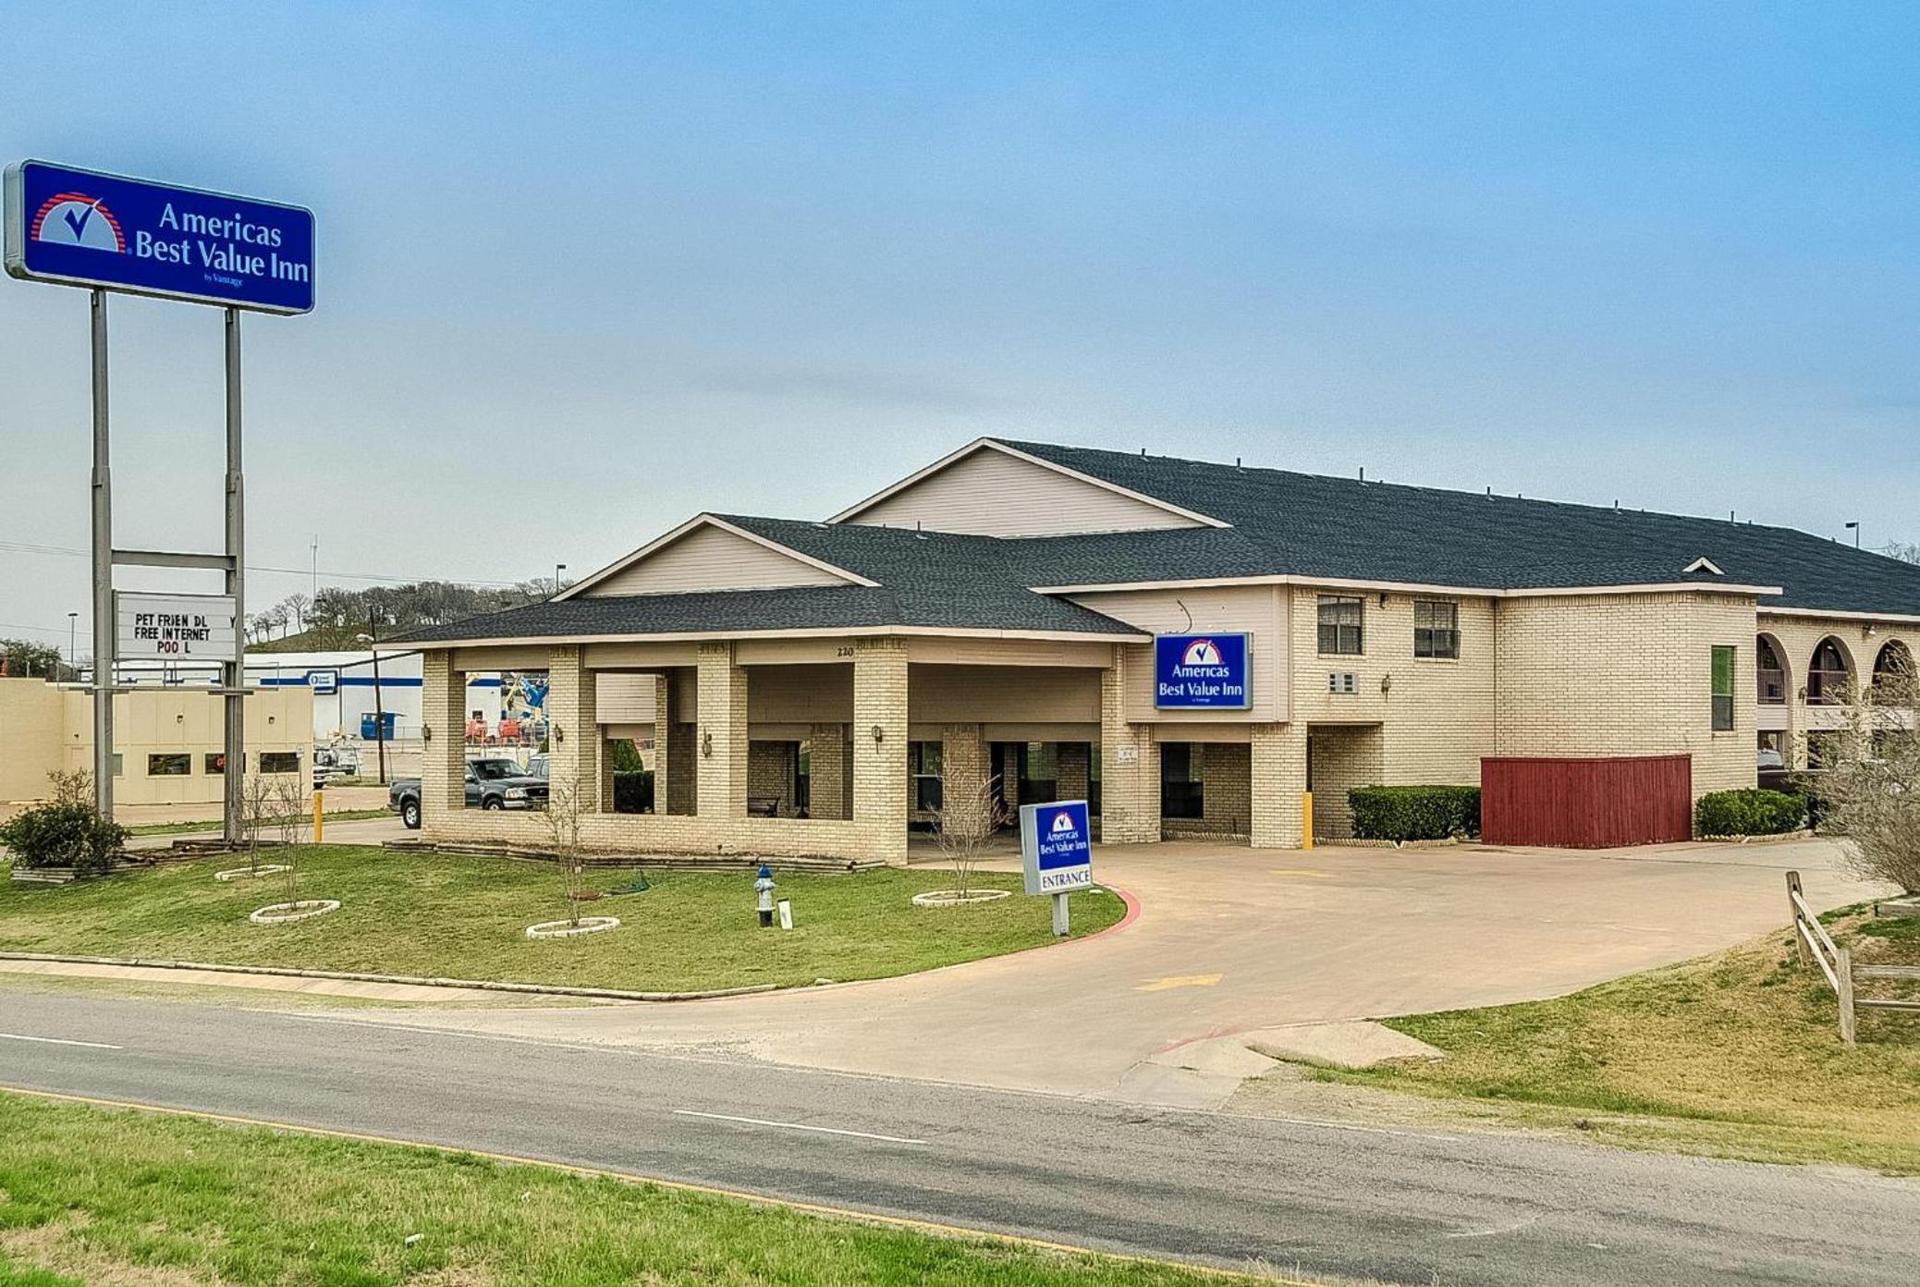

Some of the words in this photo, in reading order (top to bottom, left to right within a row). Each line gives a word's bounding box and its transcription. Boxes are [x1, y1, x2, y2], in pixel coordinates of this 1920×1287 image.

[159, 203, 281, 247] Americas
[136, 230, 191, 265] Best
[198, 240, 265, 276] Value
[271, 252, 308, 282] Inn
[135, 613, 155, 626] PET
[134, 627, 159, 640] FREE
[162, 628, 211, 641] INTERNET
[1172, 663, 1230, 678] Americas
[1159, 682, 1184, 696] Best
[1187, 680, 1220, 696] Value
[1222, 681, 1243, 696] Inn
[1046, 830, 1079, 842] Americas
[1040, 844, 1056, 855] Best
[1056, 840, 1075, 852] Value
[1075, 840, 1087, 850] Inn
[1042, 870, 1089, 889] ENTRANCE
